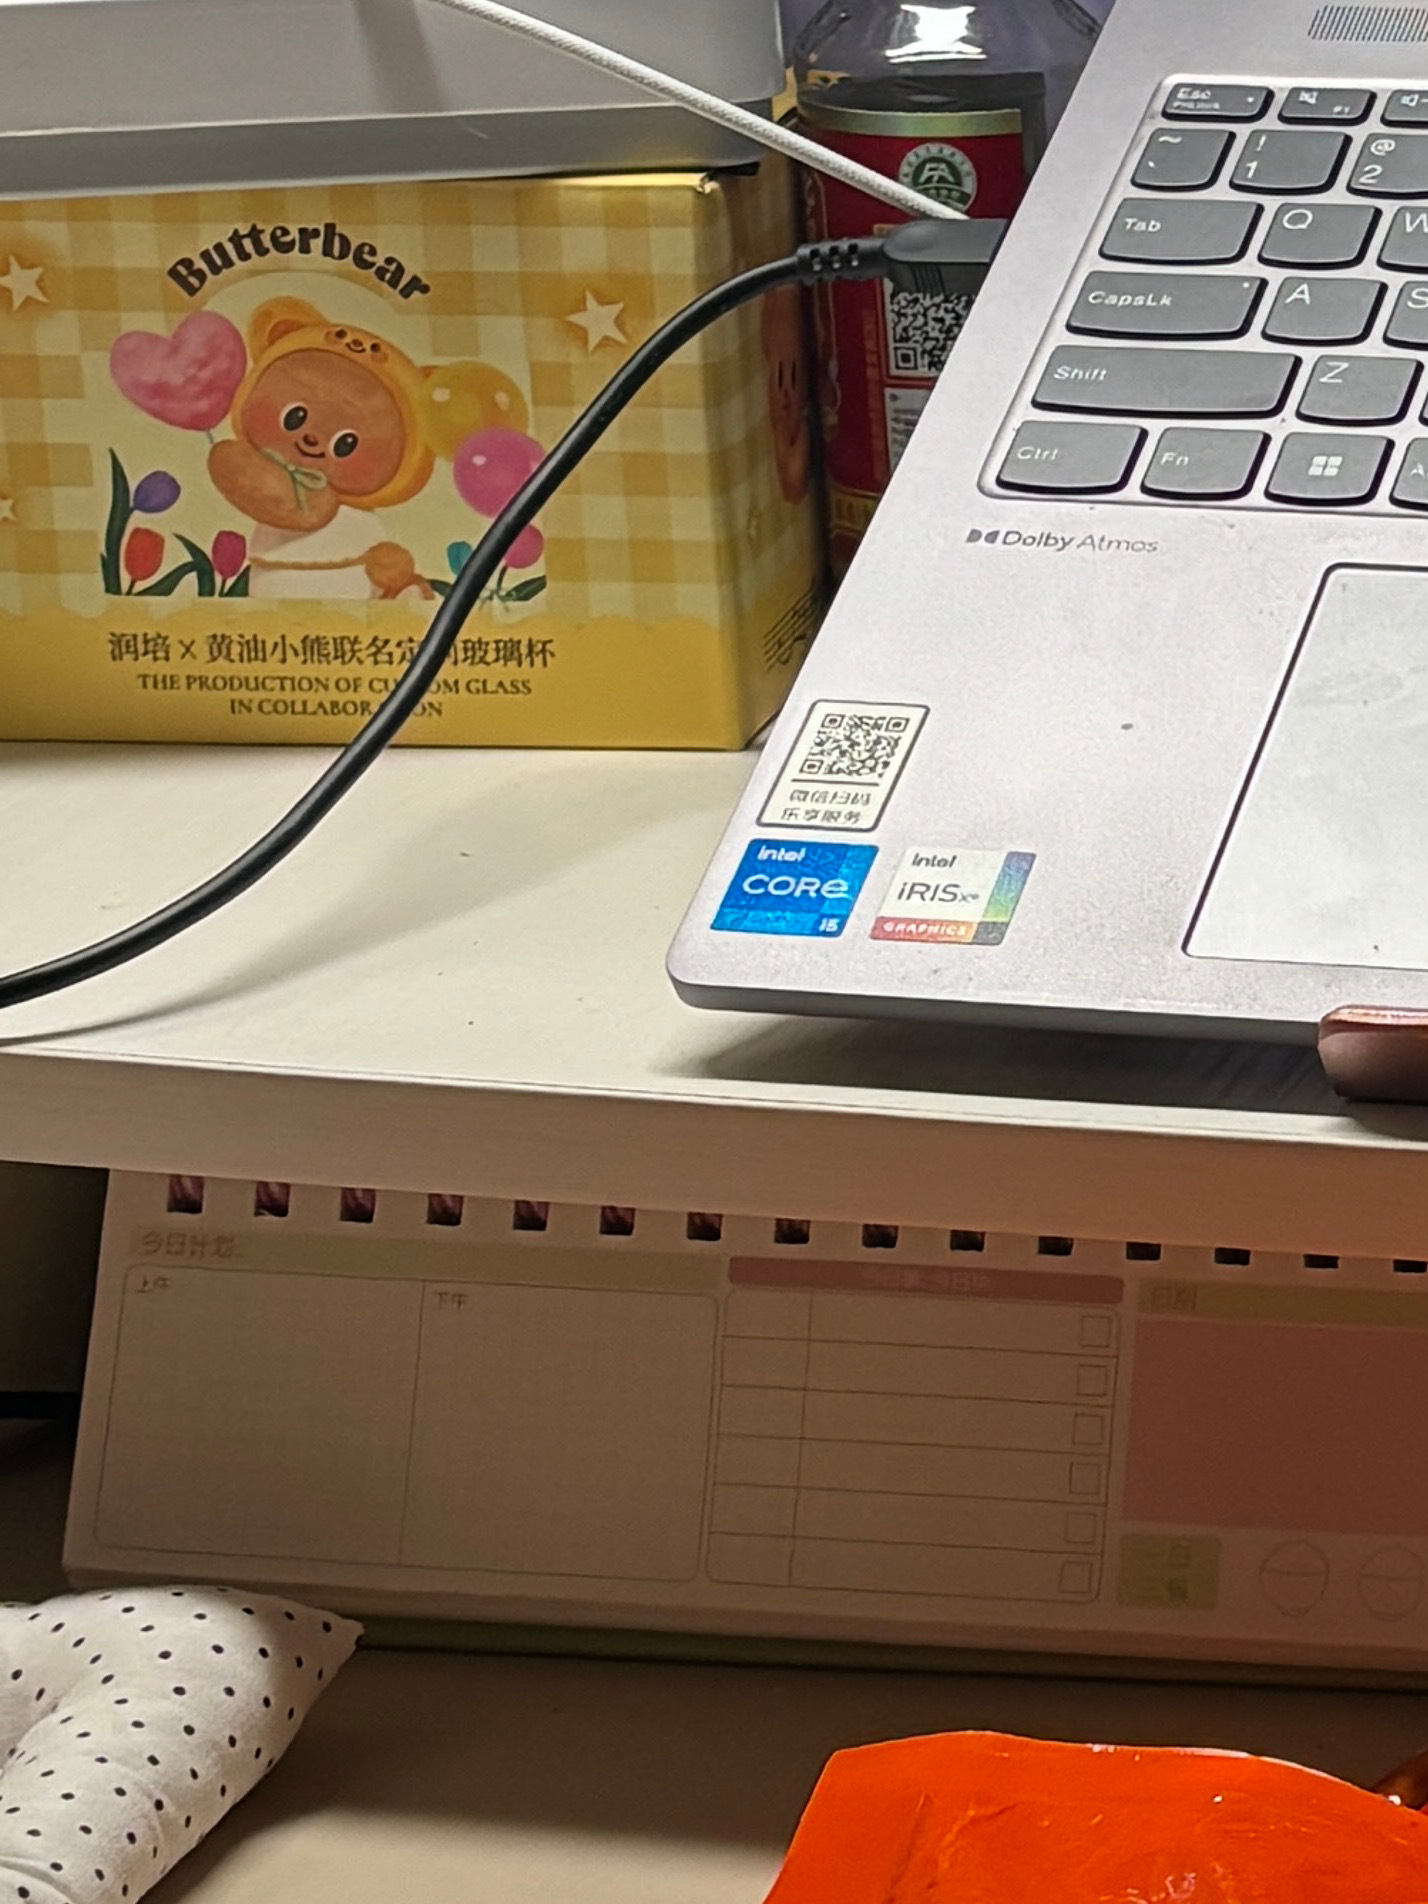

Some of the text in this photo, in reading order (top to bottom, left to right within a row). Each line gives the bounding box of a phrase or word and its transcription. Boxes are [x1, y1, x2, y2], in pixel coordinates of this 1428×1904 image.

[1247, 161, 1257, 178] 1
[1359, 165, 1382, 183] 2
[1126, 219, 1160, 231] Tab
[1283, 209, 1312, 229] Q
[166, 222, 432, 300] Butterbear
[1089, 291, 1171, 306] CapsLk
[1281, 281, 1310, 304] A
[1054, 366, 1106, 380] Shift
[1320, 362, 1349, 382] Z
[1017, 447, 1058, 460] Ctrl
[1161, 452, 1188, 465] Fn
[1001, 530, 1159, 554] Dolby Atmos
[206, 634, 557, 668] 黄油小熊联名定玻璃杯
[137, 673, 180, 691] THE
[186, 674, 330, 694] PRODUCTION
[336, 676, 362, 694] OF
[466, 678, 532, 696] GLASS
[230, 699, 252, 715] IN
[757, 845, 806, 862] intel
[912, 853, 958, 868] intel
[818, 917, 840, 933] i5
[881, 921, 967, 937] GRAPHICS
